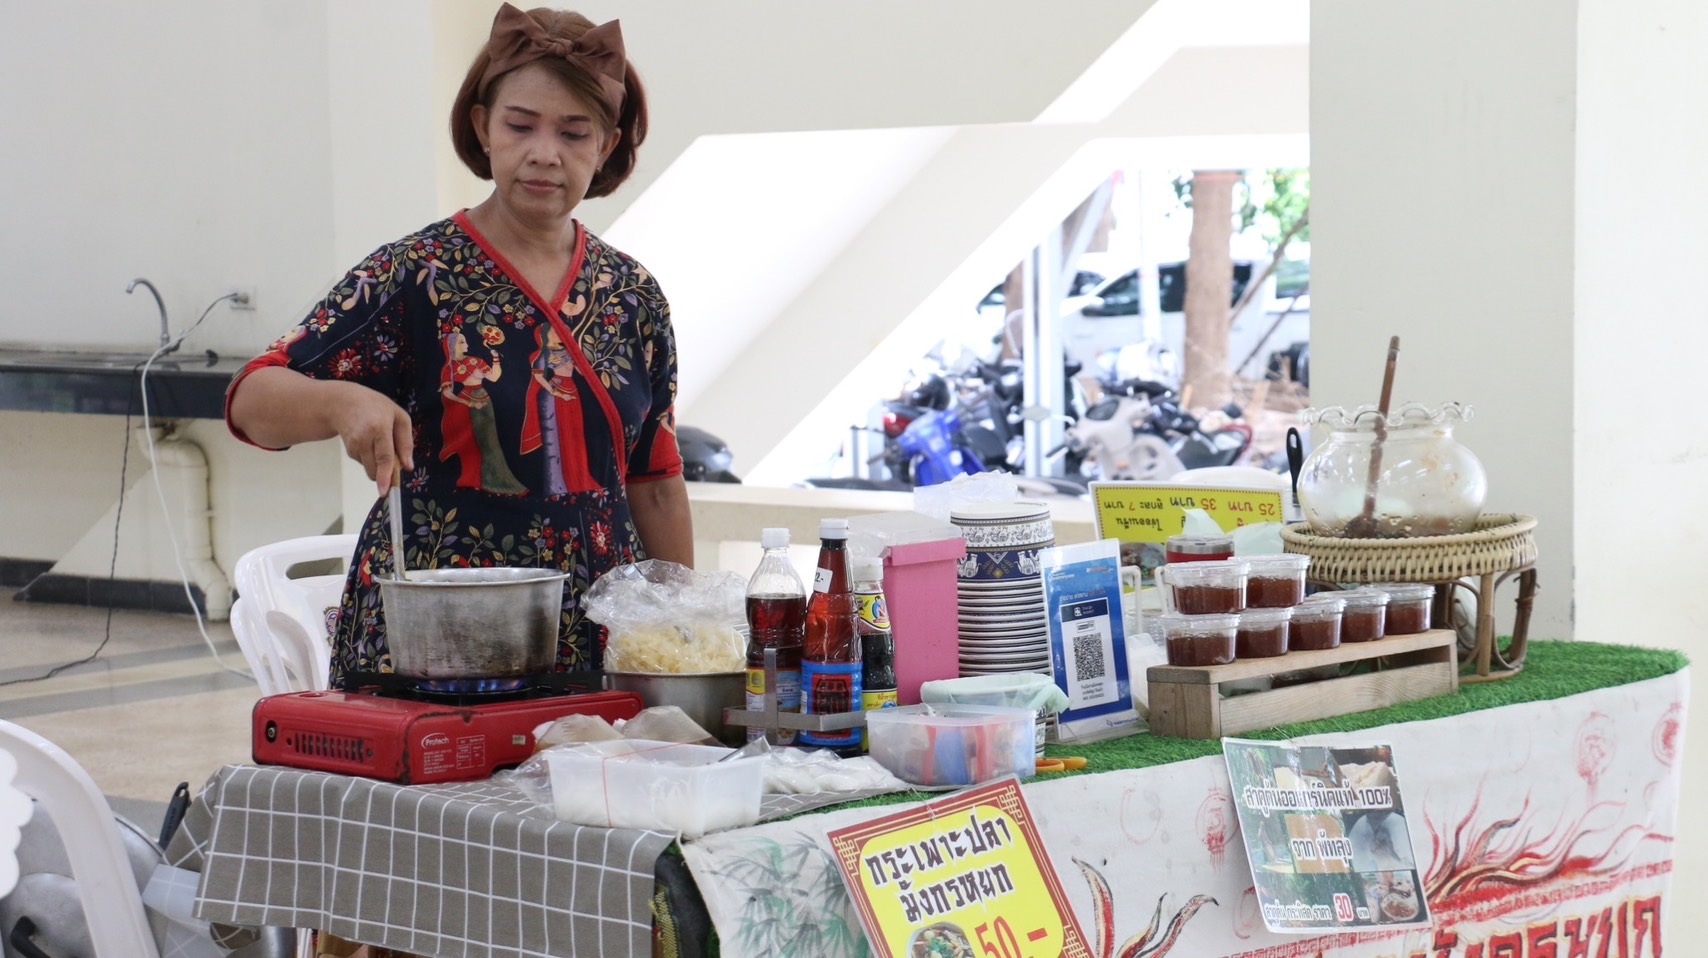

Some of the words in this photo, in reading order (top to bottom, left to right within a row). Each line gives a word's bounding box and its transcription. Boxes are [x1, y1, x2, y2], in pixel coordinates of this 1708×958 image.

[1104, 500, 1124, 509] บาท
[1170, 496, 1195, 508] บาท
[1200, 498, 1217, 510] 35
[1228, 500, 1253, 512] บาท
[1258, 503, 1275, 515] 25
[1358, 787, 1392, 806] 100%
[864, 814, 1012, 885] กระเพาะปลา
[1292, 840, 1316, 857] จาก
[1317, 830, 1353, 864] พัทลุง
[1335, 895, 1353, 919] 30
